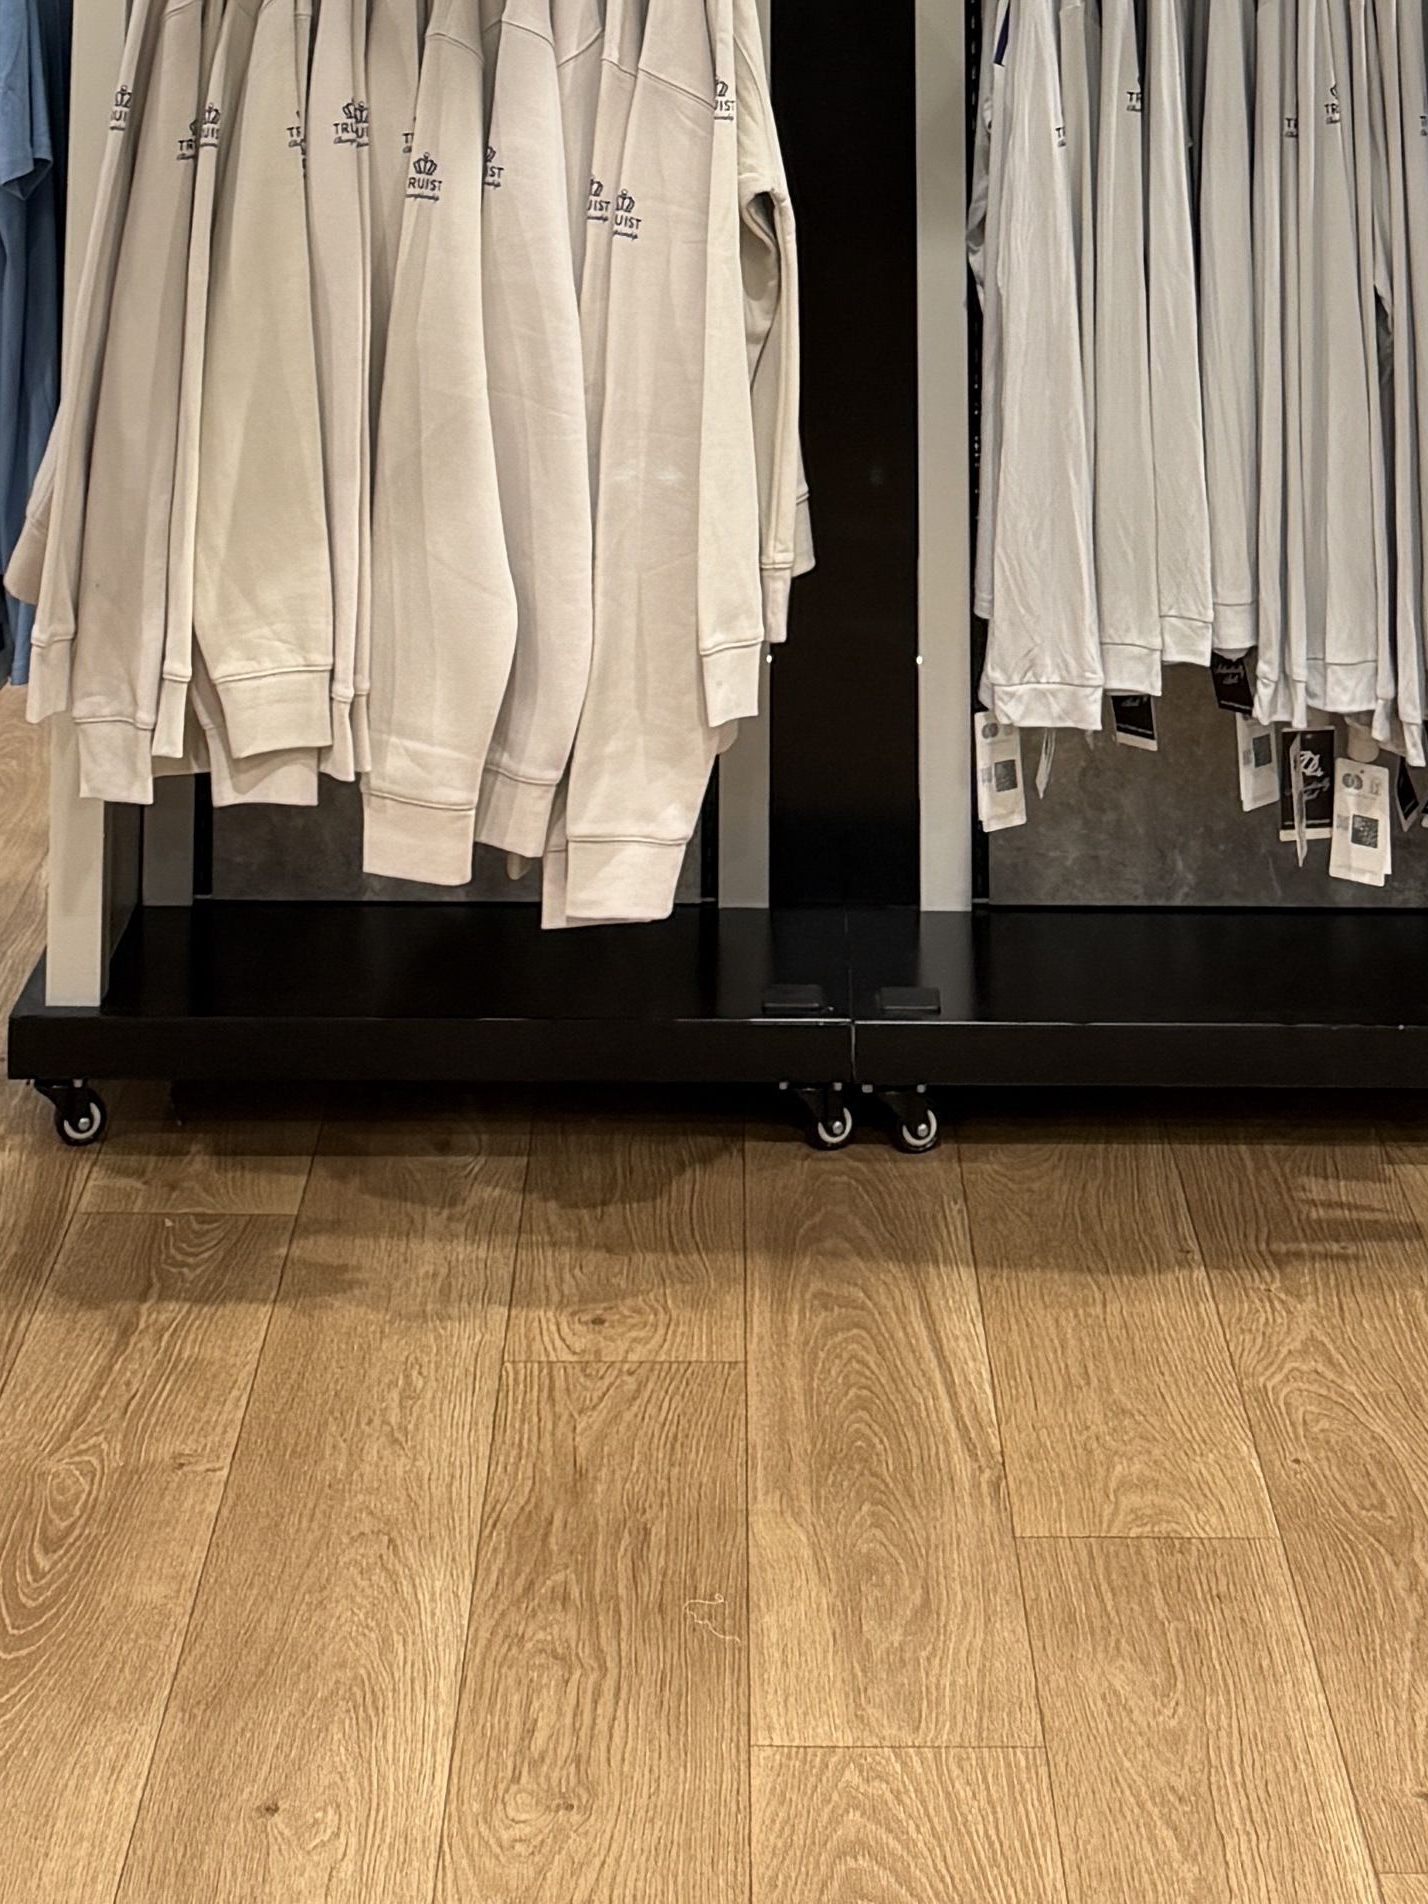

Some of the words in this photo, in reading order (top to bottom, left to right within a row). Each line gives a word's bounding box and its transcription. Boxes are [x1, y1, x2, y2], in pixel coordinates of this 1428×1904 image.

[333, 121, 356, 135] TRU
[407, 176, 443, 192] RUIST
[615, 215, 642, 230] UIST
